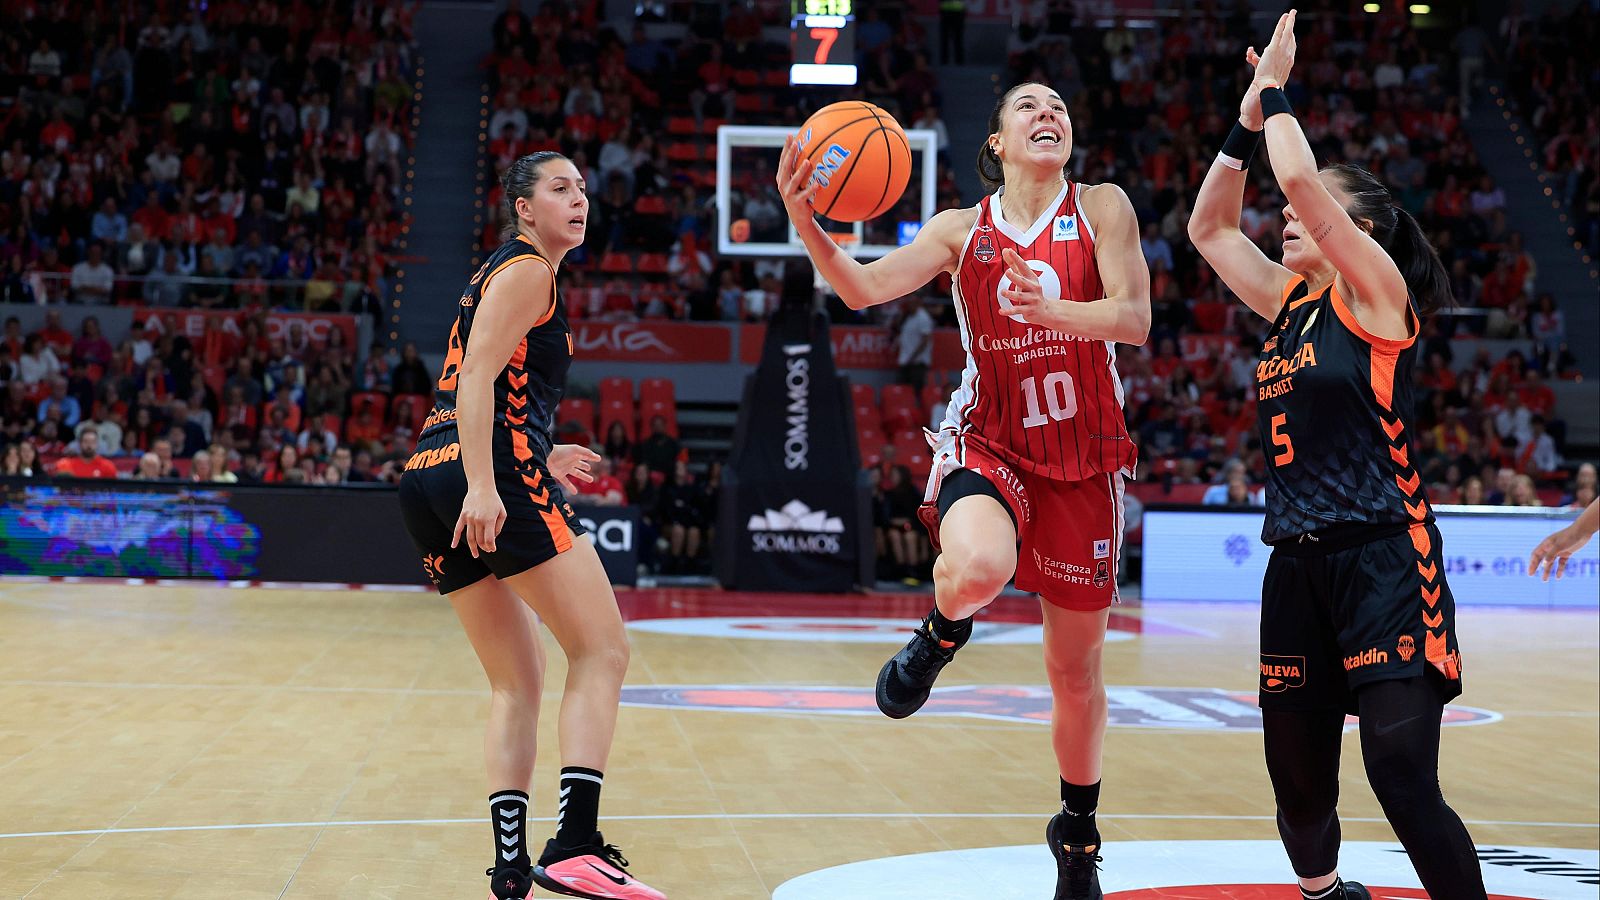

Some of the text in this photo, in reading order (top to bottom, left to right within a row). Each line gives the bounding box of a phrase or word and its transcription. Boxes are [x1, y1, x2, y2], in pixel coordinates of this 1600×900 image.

[810, 28, 838, 64] 7
[978, 327, 1097, 352] Casademo
[1013, 345, 1067, 364] ZARAGOZA
[1021, 371, 1078, 428] 10
[1259, 377, 1294, 401] BASKET
[784, 358, 809, 470] SOMMOS
[1271, 413, 1295, 467] 5
[752, 532, 840, 553] SOMMOS
[1044, 556, 1091, 575] Zaragoza
[1044, 566, 1091, 585] DEPORTE
[1260, 662, 1301, 678] ULEVA
